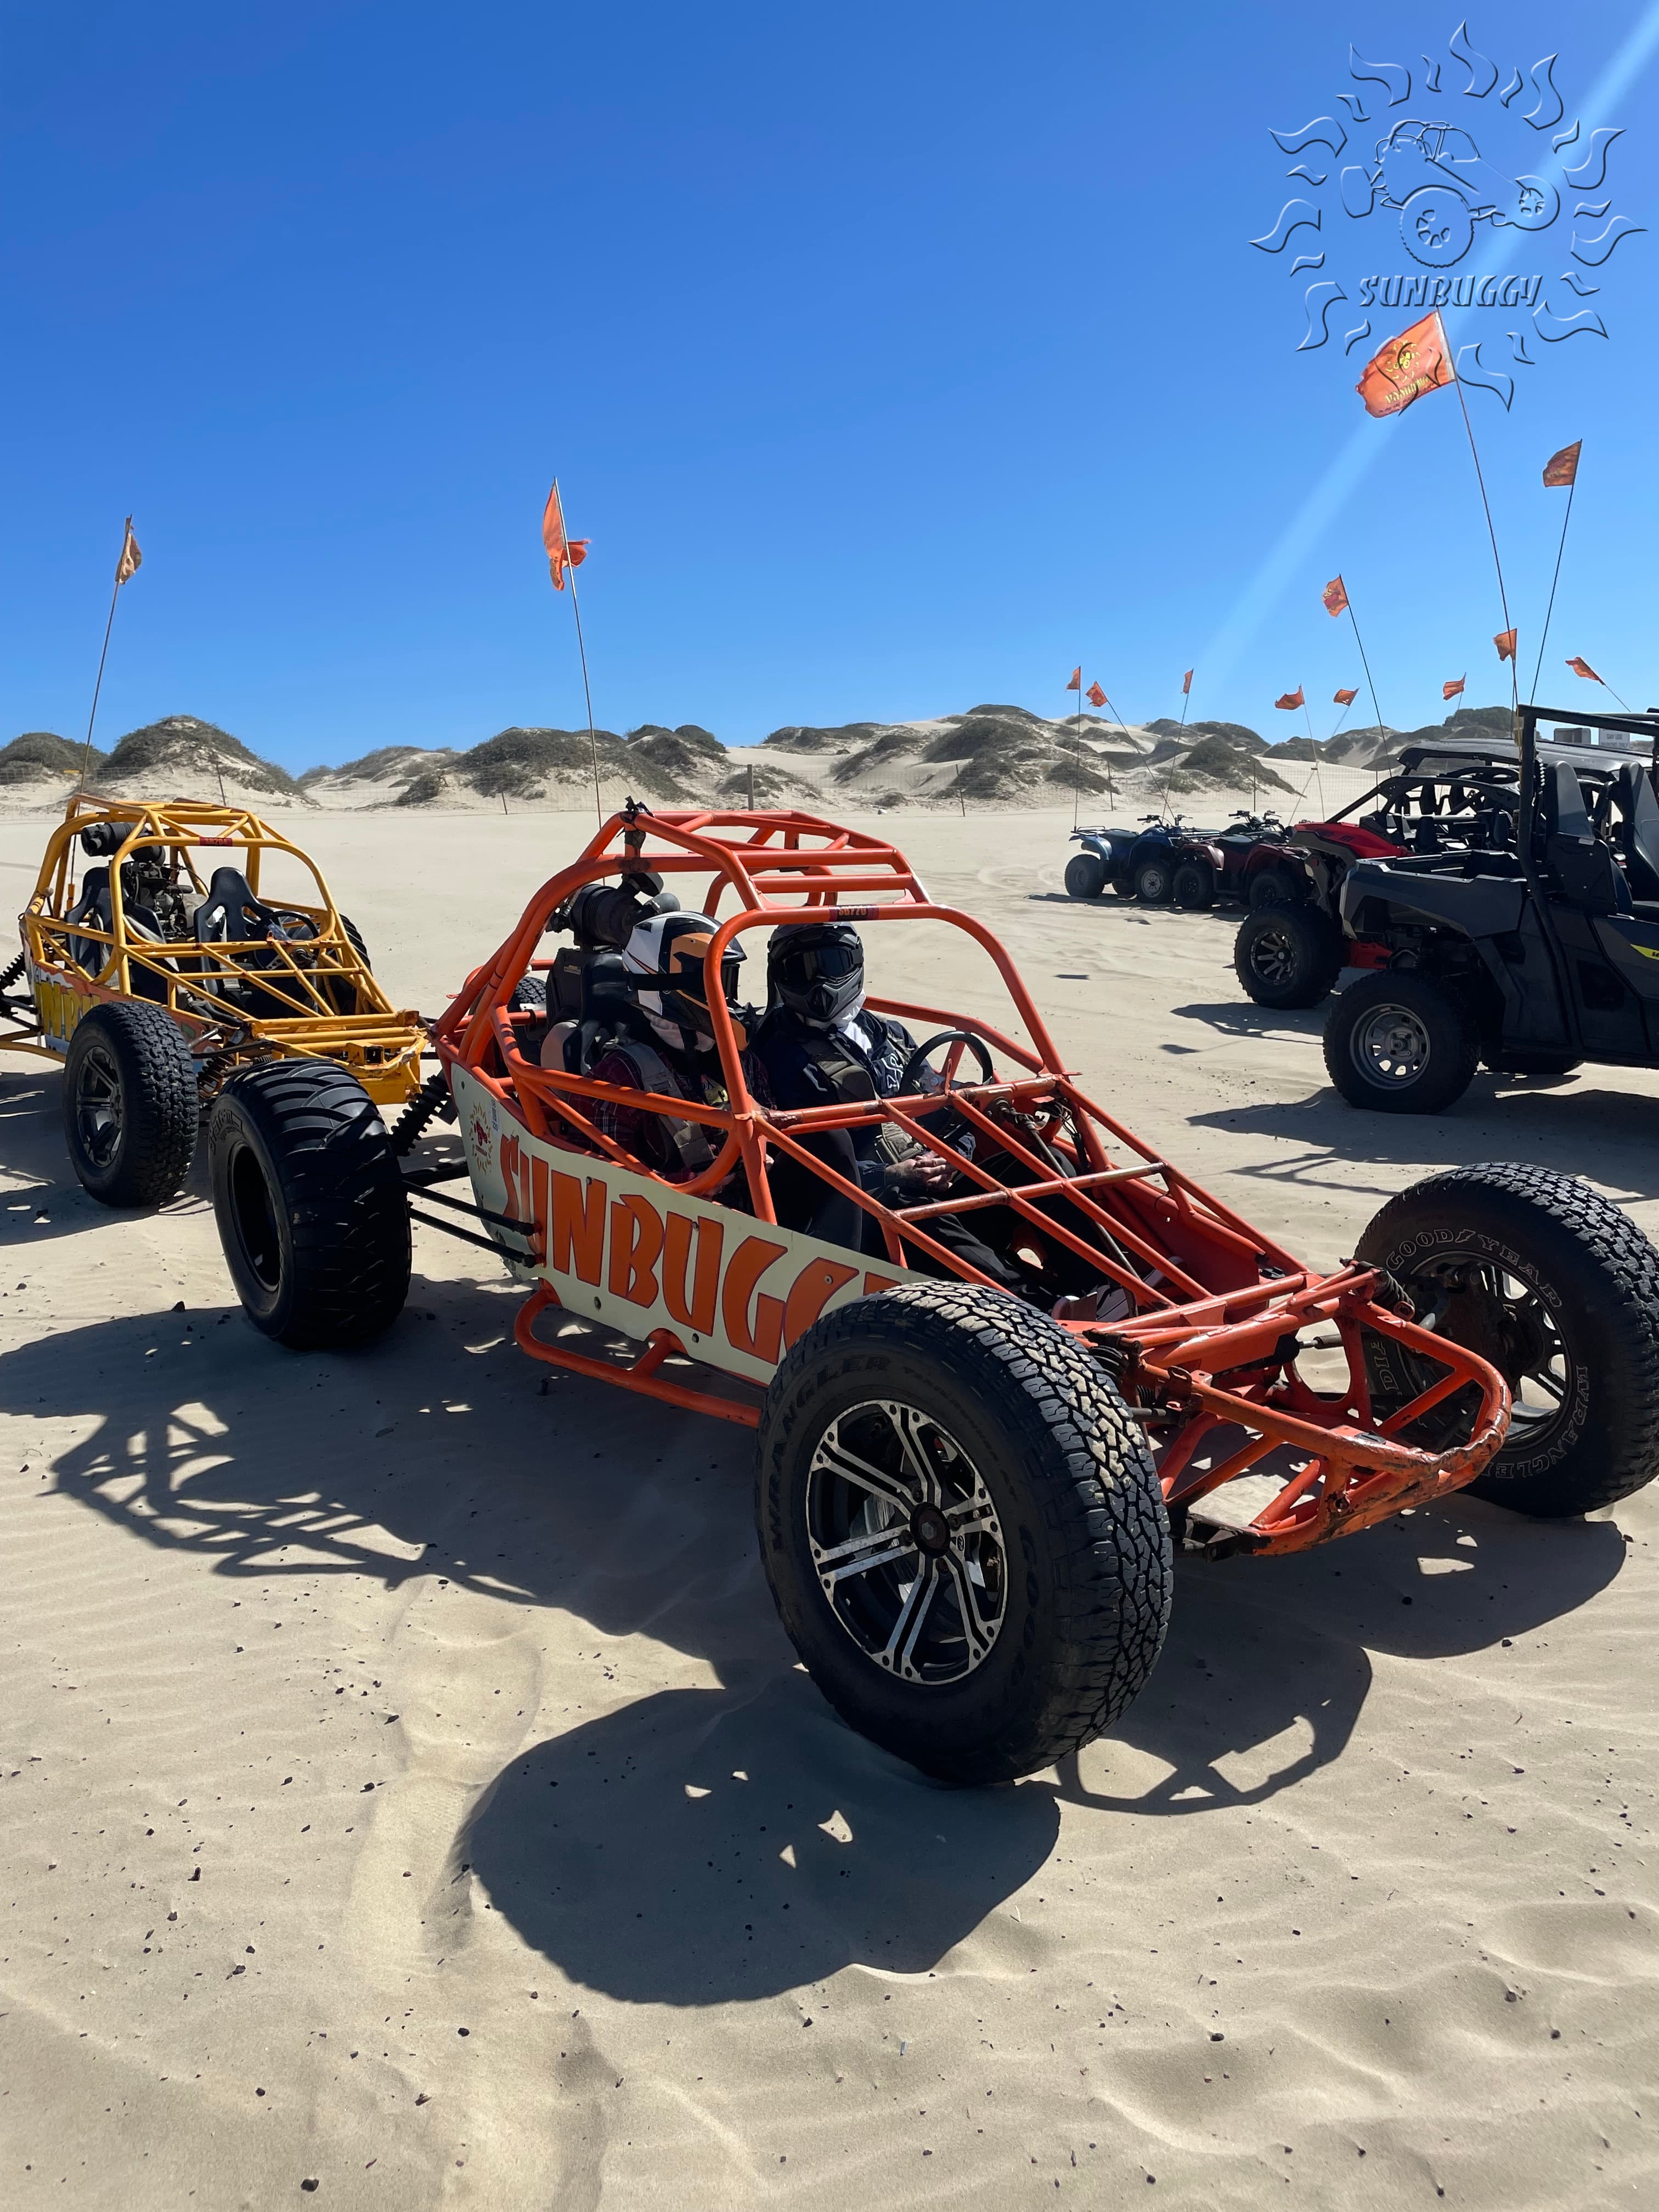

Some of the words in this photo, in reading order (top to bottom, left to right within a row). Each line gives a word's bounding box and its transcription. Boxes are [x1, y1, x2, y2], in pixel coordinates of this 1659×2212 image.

[499, 1132, 901, 1366] SUNBUGG
[1386, 1228, 1562, 1308] GOODYEAR
[769, 1355, 890, 1550] WRANGLER
